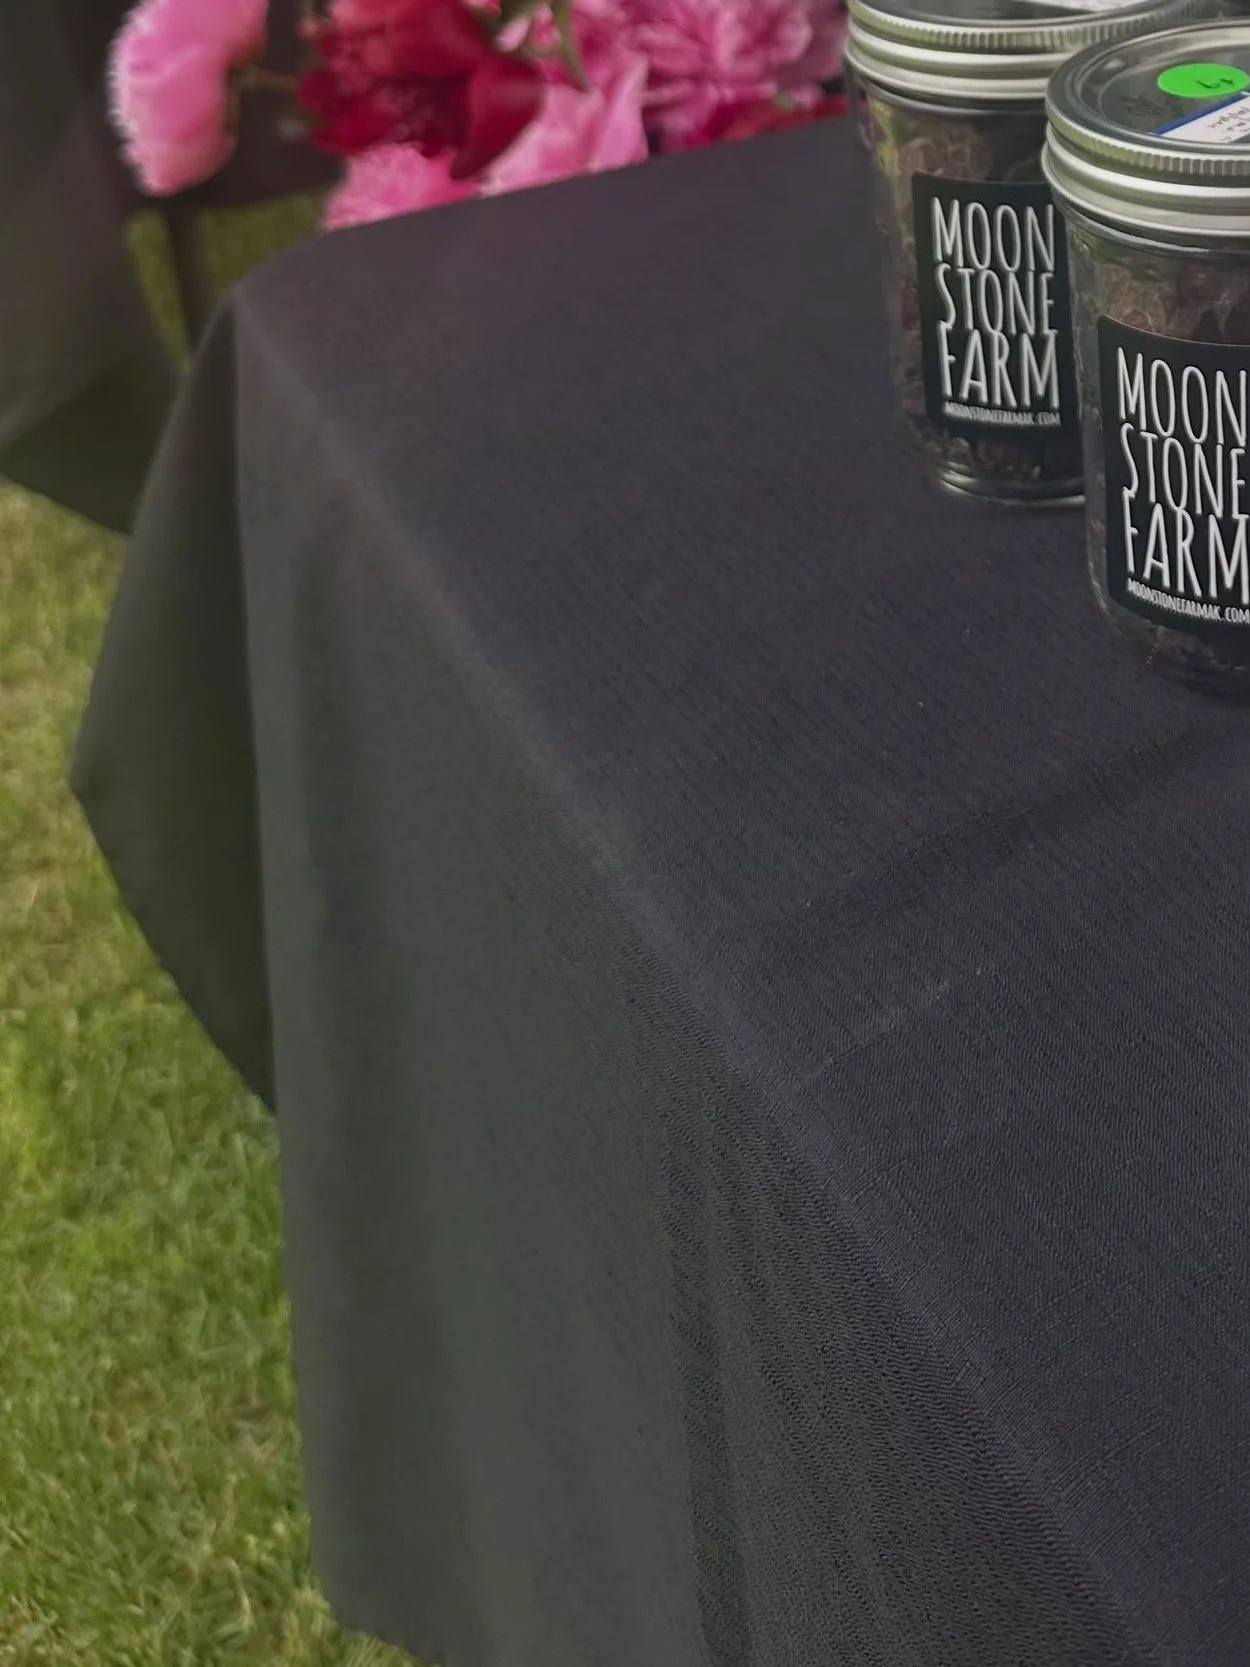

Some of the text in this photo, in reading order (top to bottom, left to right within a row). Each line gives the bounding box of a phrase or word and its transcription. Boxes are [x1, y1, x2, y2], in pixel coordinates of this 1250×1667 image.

[931, 196, 1056, 274] MOON
[935, 262, 1059, 336] STONE
[936, 320, 1061, 411] FARM
[1117, 346, 1248, 448] MOON
[1119, 422, 1250, 519] STONE
[1121, 486, 1250, 606] FARM
